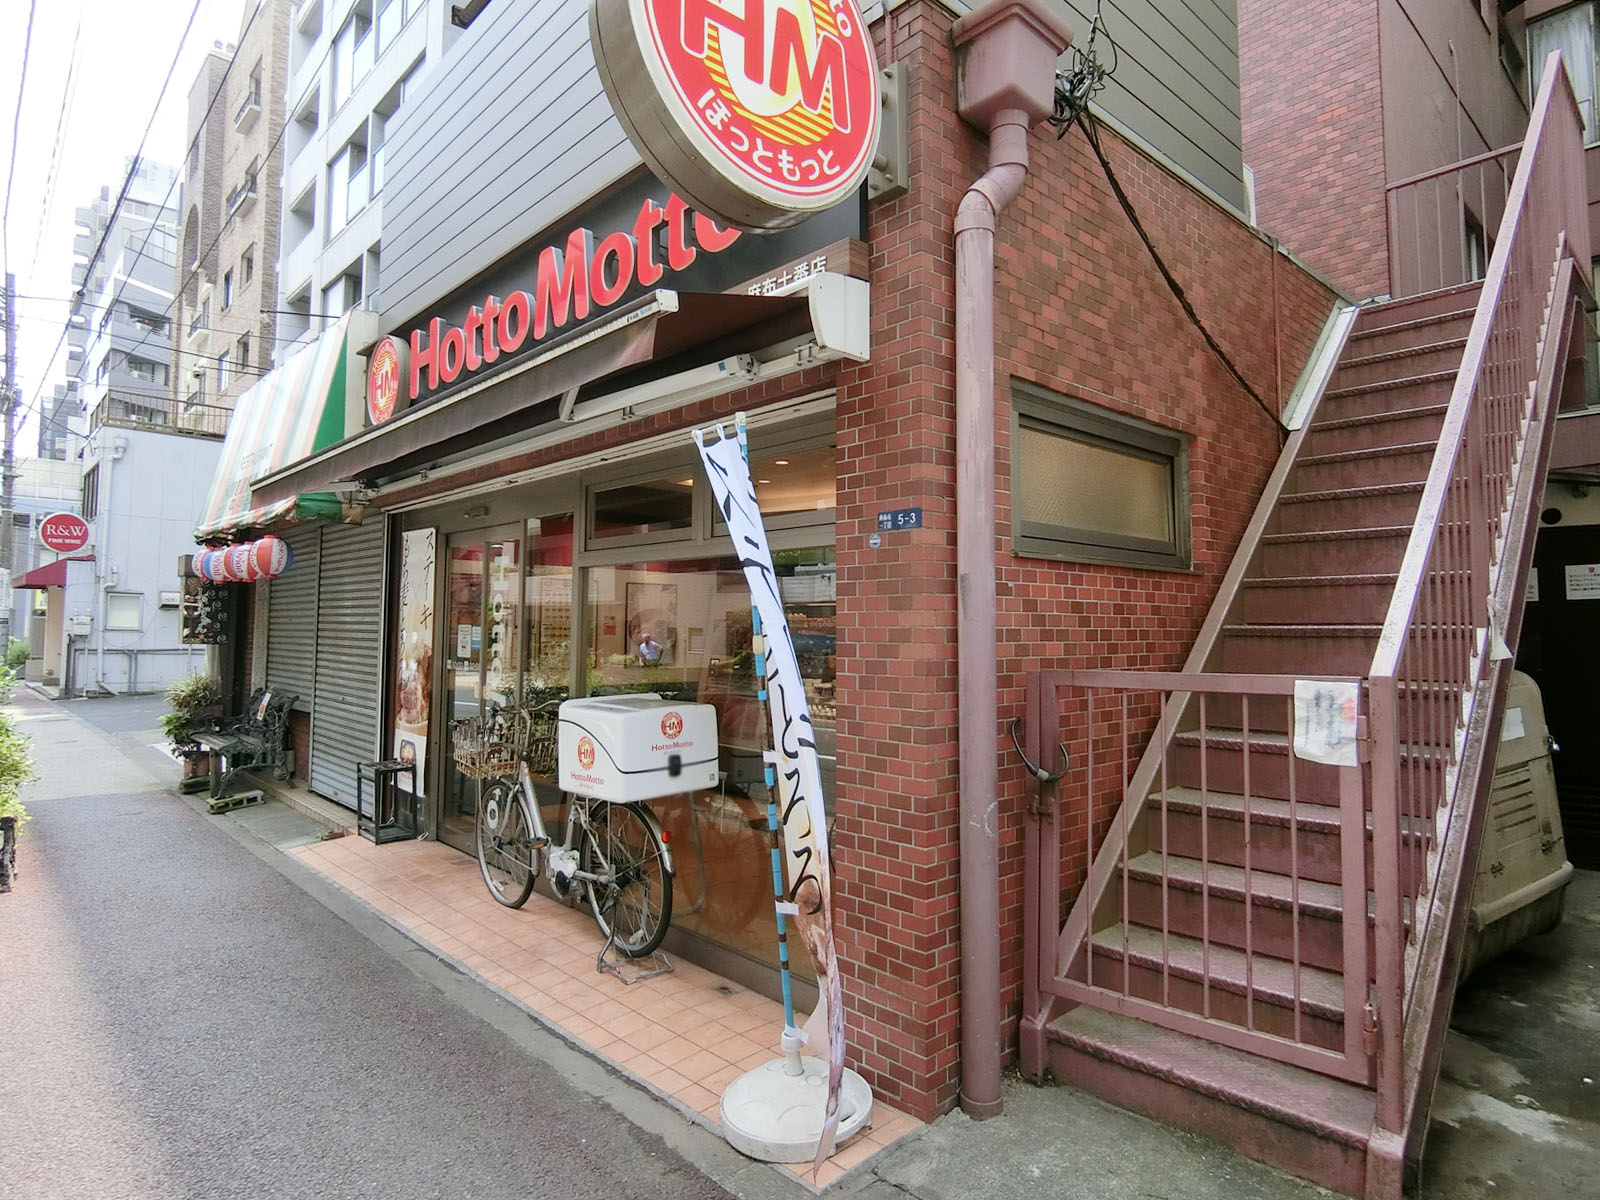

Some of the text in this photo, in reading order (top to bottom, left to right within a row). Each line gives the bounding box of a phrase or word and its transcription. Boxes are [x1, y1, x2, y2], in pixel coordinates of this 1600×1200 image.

[697, 88, 841, 182] ほっともっと
[748, 255, 828, 296] 麻布十番店
[897, 512, 916, 525] 5-3
[47, 524, 86, 537] R&W
[419, 531, 434, 631] ステーキ
[663, 719, 681, 731] HM
[651, 741, 694, 752] HottoMotto
[579, 747, 594, 760] HM
[570, 771, 605, 785] HottoMotto
